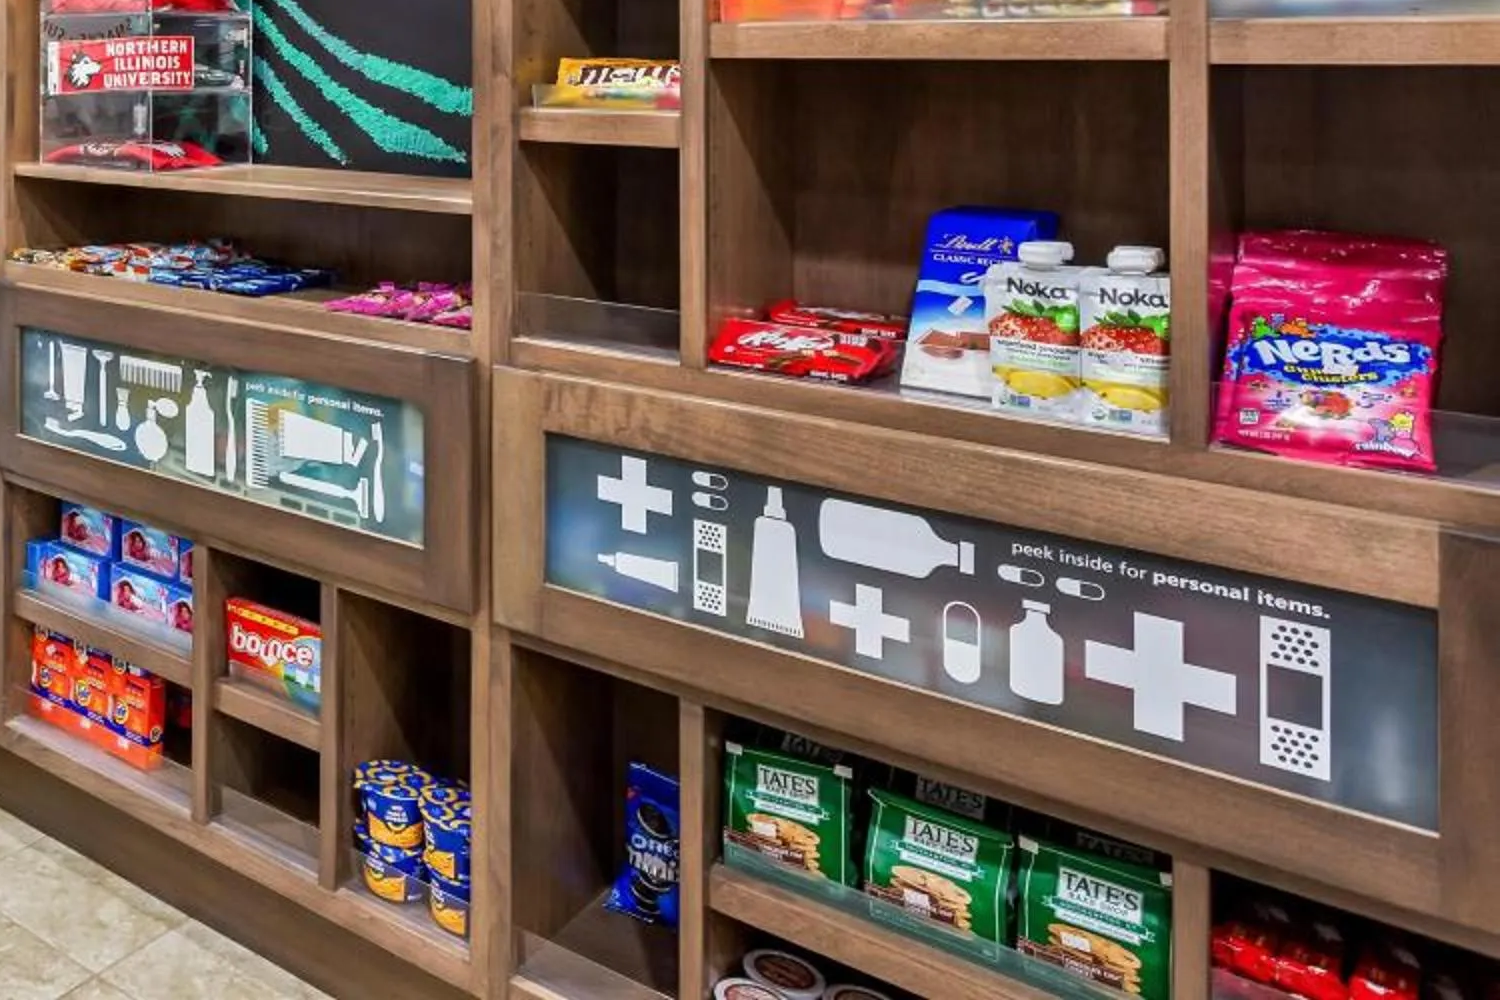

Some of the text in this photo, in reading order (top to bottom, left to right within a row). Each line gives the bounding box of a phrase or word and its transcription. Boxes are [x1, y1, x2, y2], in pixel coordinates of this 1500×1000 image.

[106, 40, 187, 57] NORTHERN
[114, 56, 180, 71] ILLINOIS
[103, 71, 191, 89] UNIVERSITY
[932, 252, 975, 266] CLASSIC
[1006, 277, 1069, 300] Noka
[1099, 287, 1169, 309] Noka
[1011, 541, 1331, 619] peek inside for personal items.
[231, 622, 315, 667] bounce
[759, 767, 816, 795] TATE'S
[911, 820, 975, 853] TATE'S
[1062, 871, 1140, 911] TATE'S
